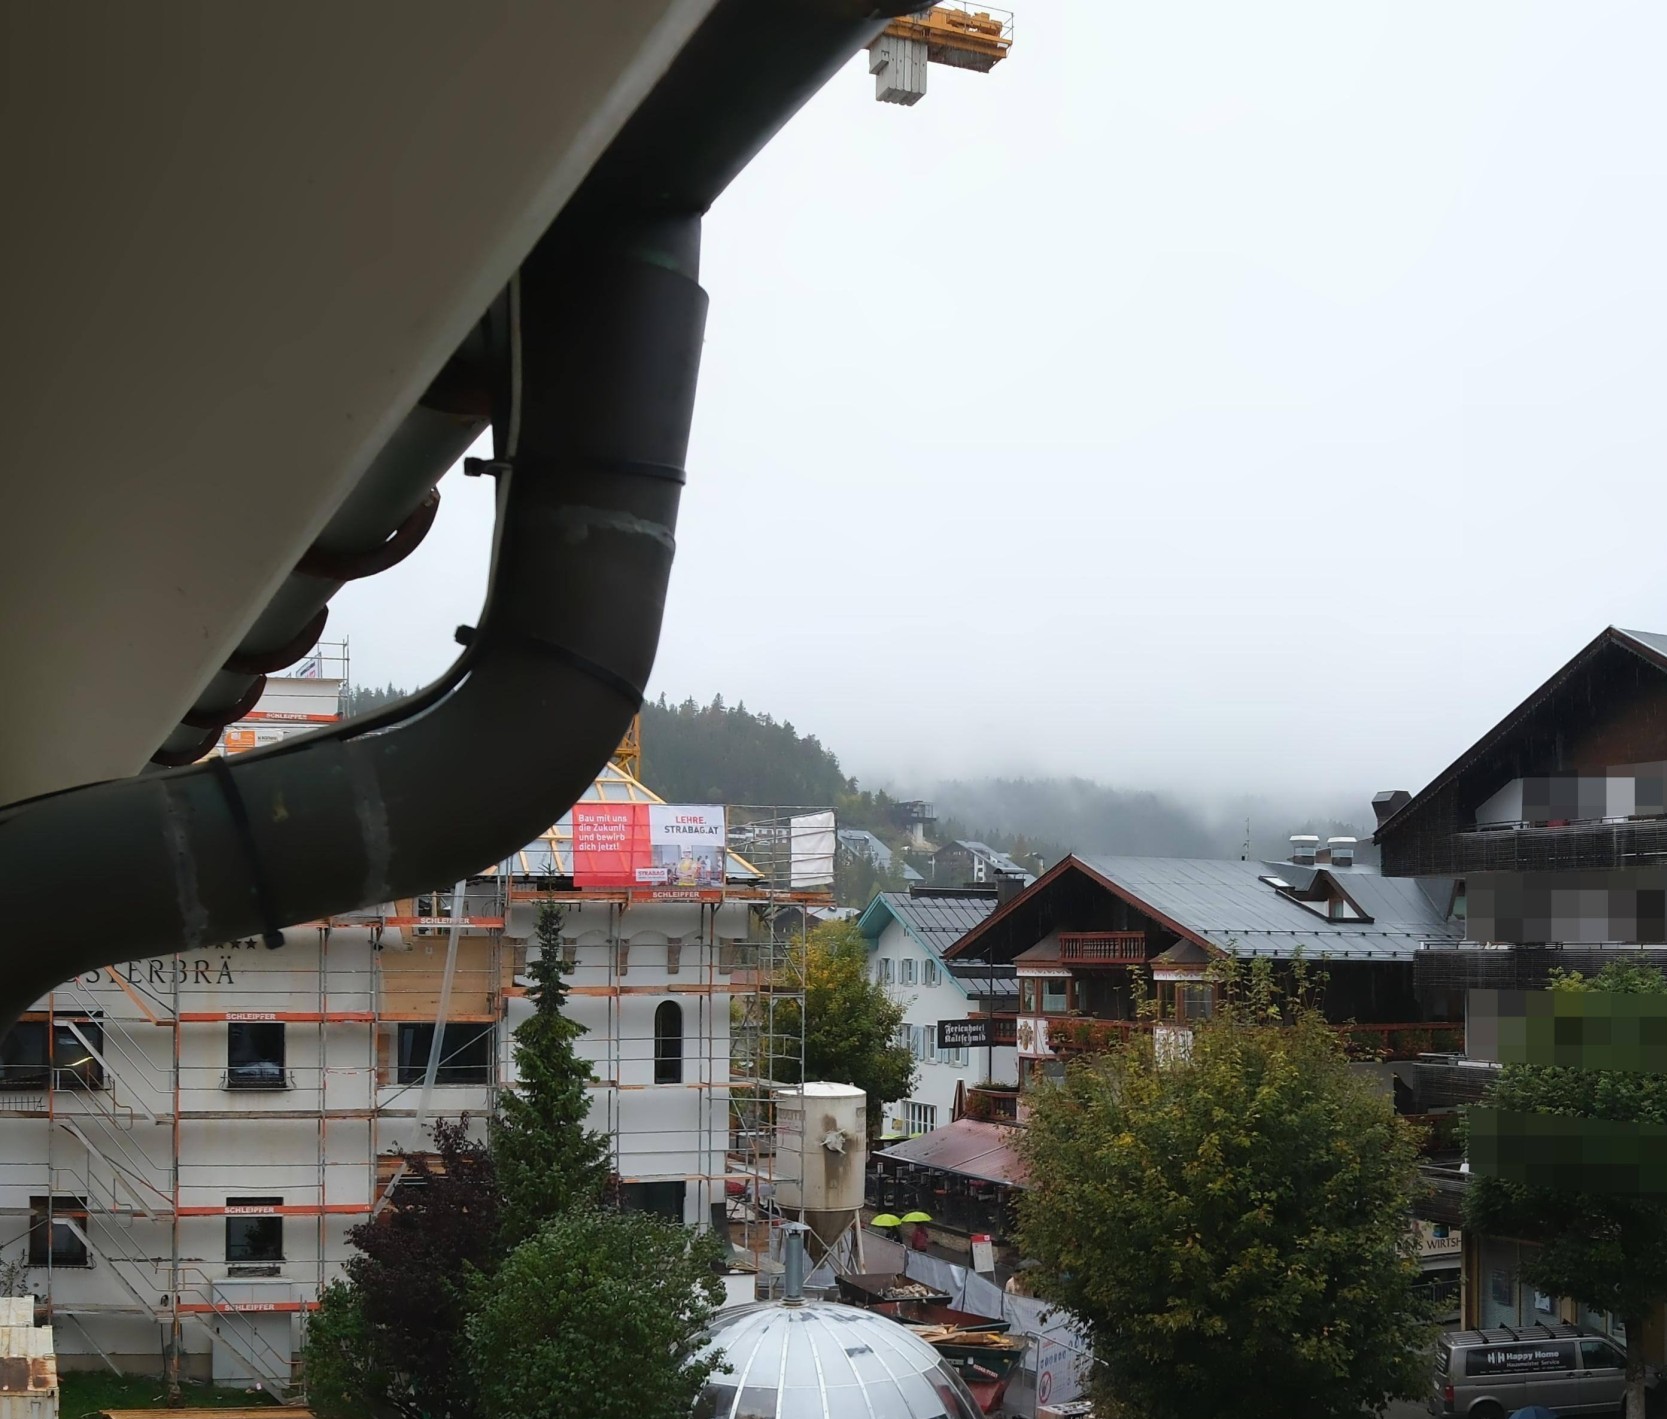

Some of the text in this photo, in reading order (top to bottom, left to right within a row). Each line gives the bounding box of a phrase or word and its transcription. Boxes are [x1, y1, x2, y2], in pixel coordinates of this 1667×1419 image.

[578, 814, 594, 822] Bau
[596, 814, 610, 822] mit
[675, 816, 707, 824] LEHRE.
[578, 824, 625, 832] die Zukunft
[664, 826, 719, 835] STRABAG.AT
[579, 833, 625, 841] und bewirb
[579, 842, 619, 851] dich jetzt!
[1506, 1353, 1533, 1361] Happy
